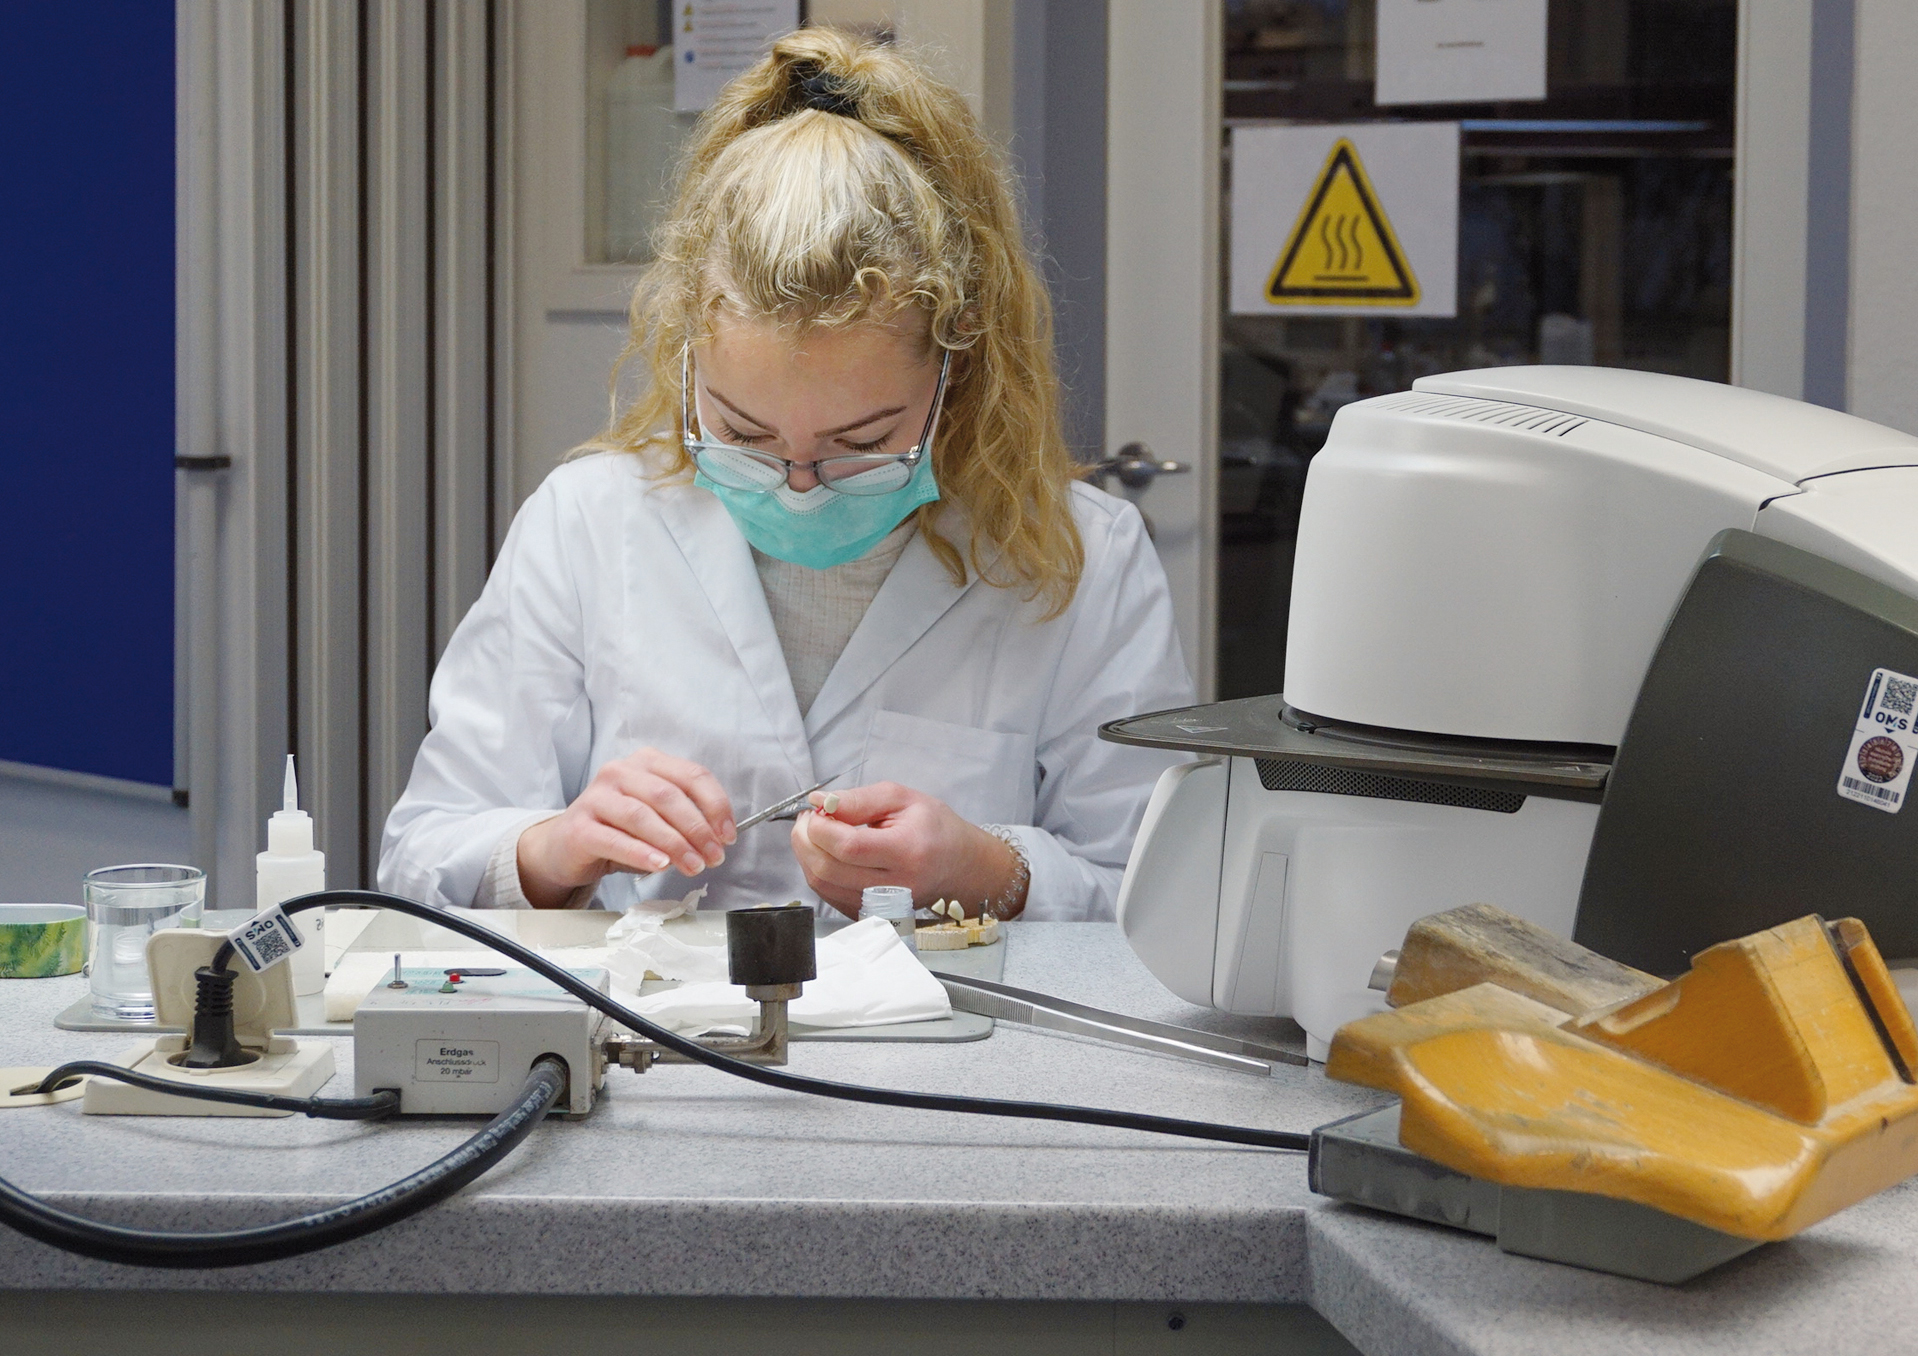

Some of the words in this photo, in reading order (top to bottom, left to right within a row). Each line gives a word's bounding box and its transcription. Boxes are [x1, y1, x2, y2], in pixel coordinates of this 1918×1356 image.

[1875, 711, 1909, 730] OMS
[245, 920, 274, 940] OMS
[440, 1047, 474, 1057] Erdgas
[440, 1067, 450, 1075] 20
[452, 1067, 472, 1075] mbar
